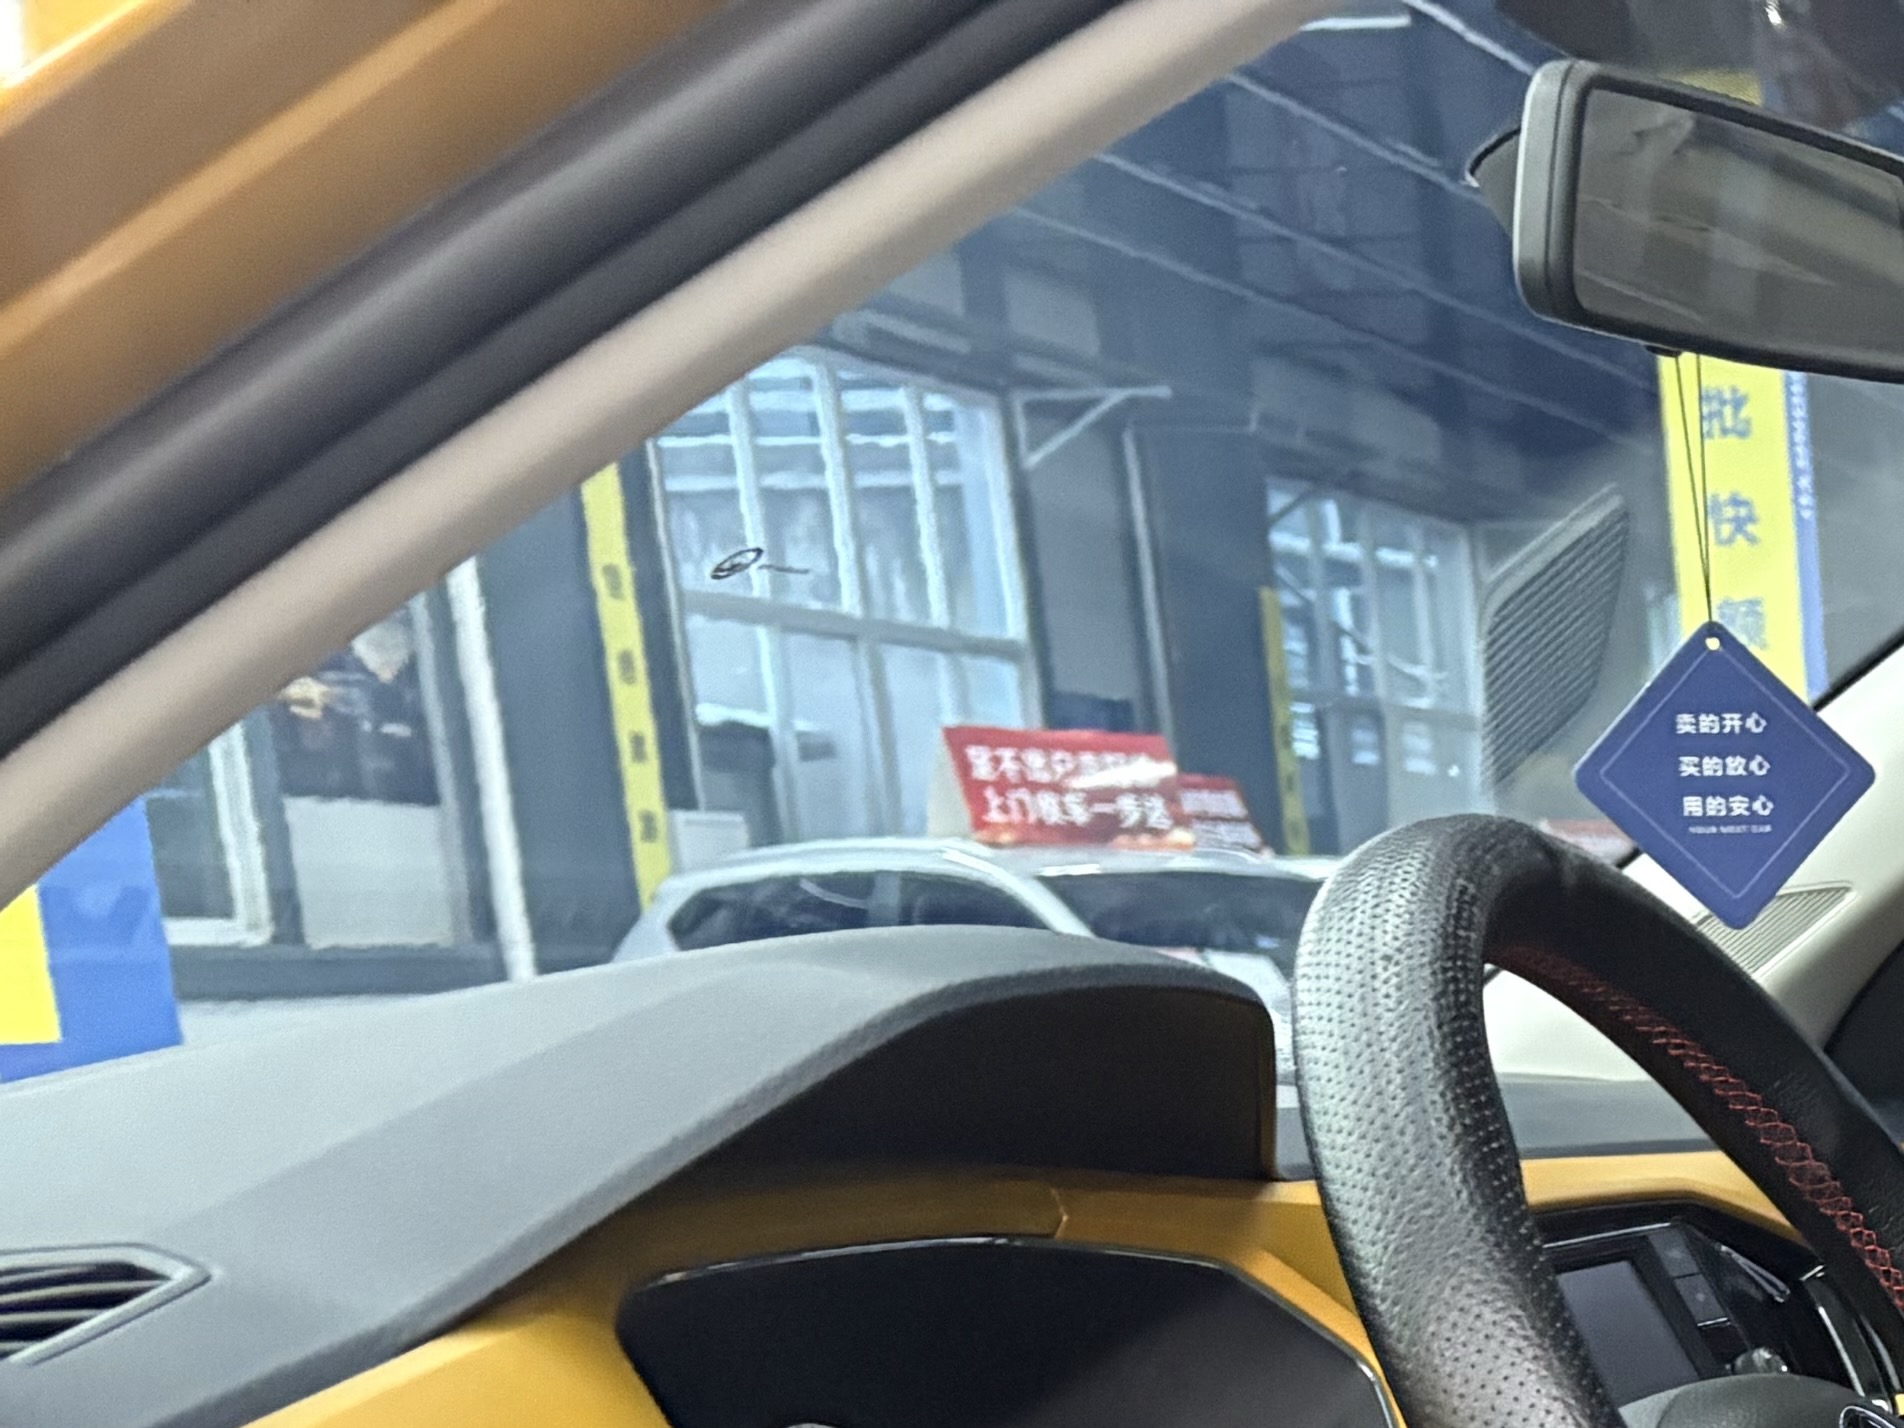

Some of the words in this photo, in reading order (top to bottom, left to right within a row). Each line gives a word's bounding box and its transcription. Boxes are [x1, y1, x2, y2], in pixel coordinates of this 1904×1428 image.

[1675, 712, 1767, 734] 卖的开心
[1678, 755, 1771, 777] 买的放心
[1682, 794, 1774, 817] 用的安心
